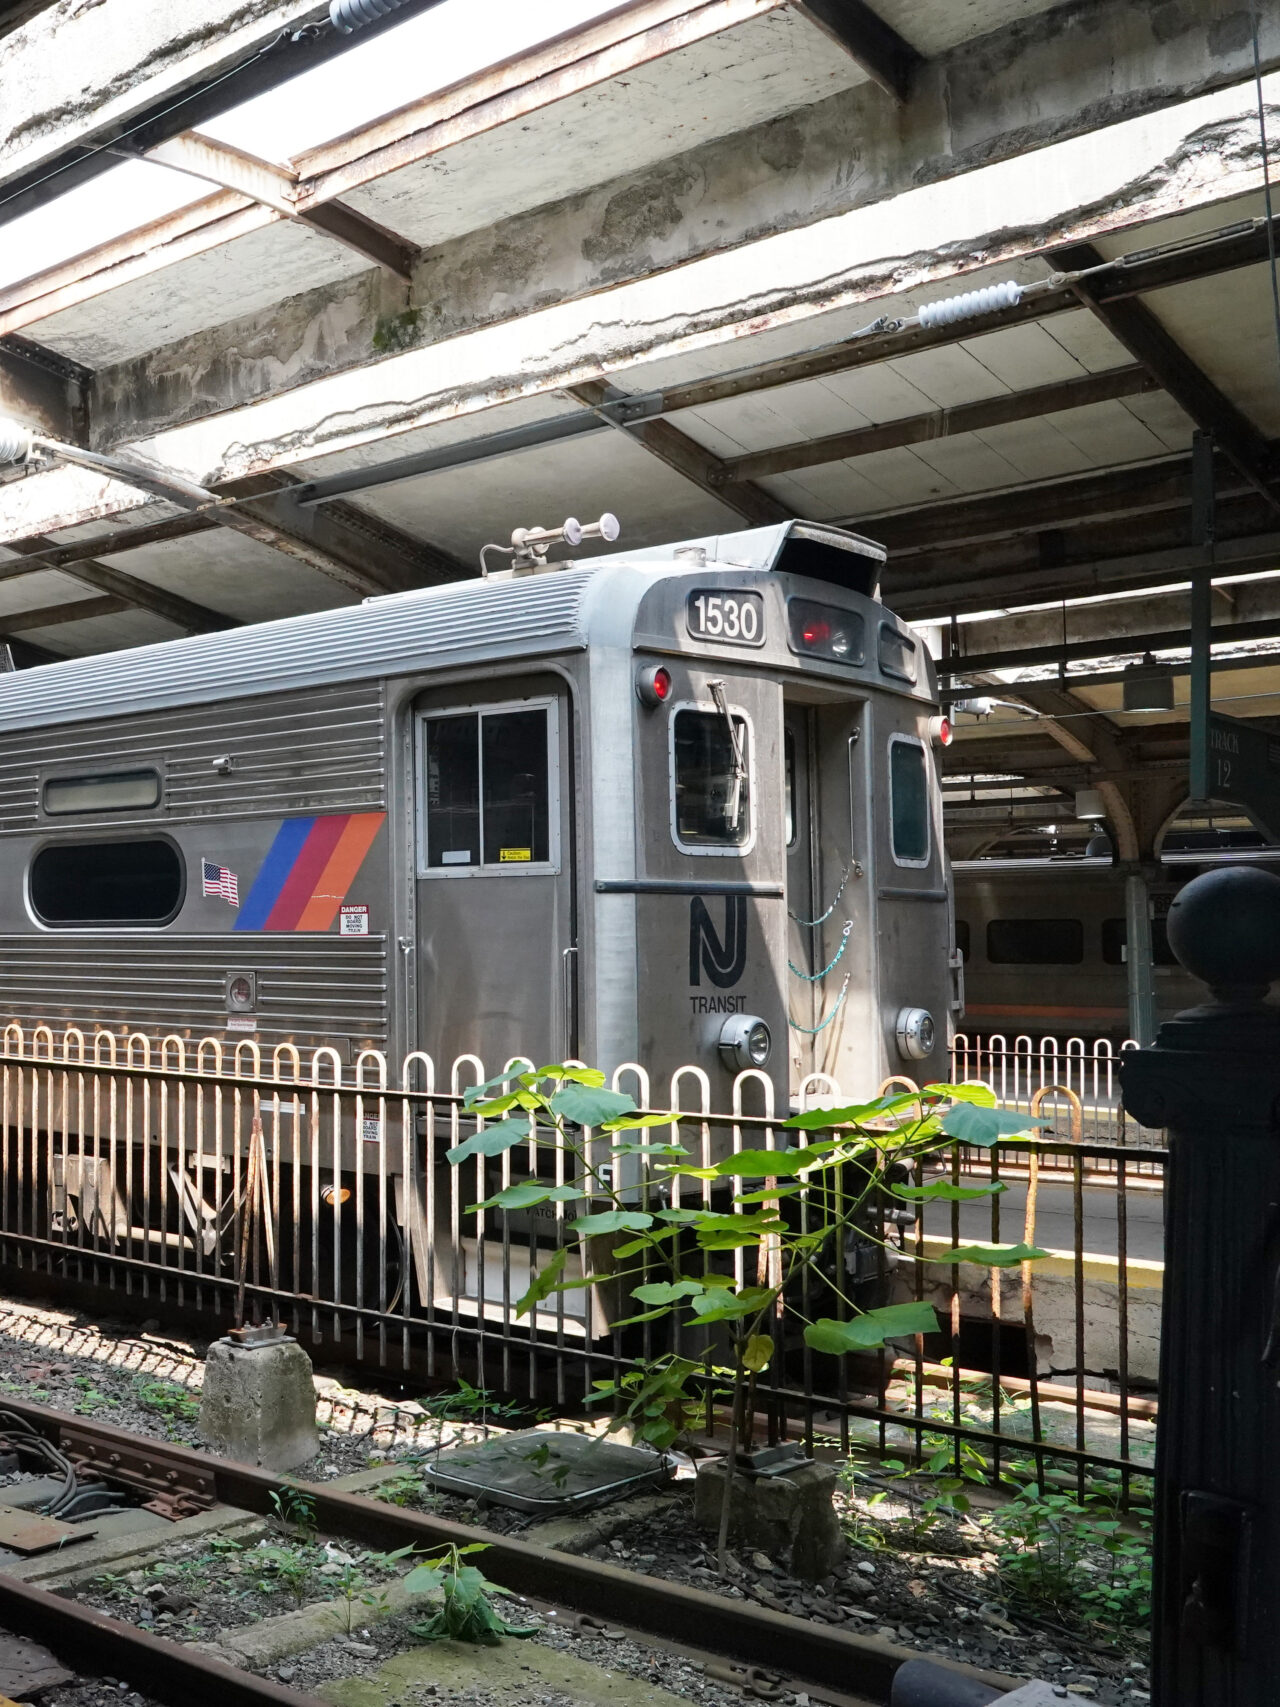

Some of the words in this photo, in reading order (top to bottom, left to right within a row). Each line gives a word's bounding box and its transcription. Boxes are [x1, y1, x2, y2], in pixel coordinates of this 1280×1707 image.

[694, 595, 758, 640] 1530
[1210, 728, 1240, 754] TRACK
[1217, 759, 1231, 788] 12
[689, 895, 747, 989] NJ
[689, 995, 747, 1014] TRANSIT
